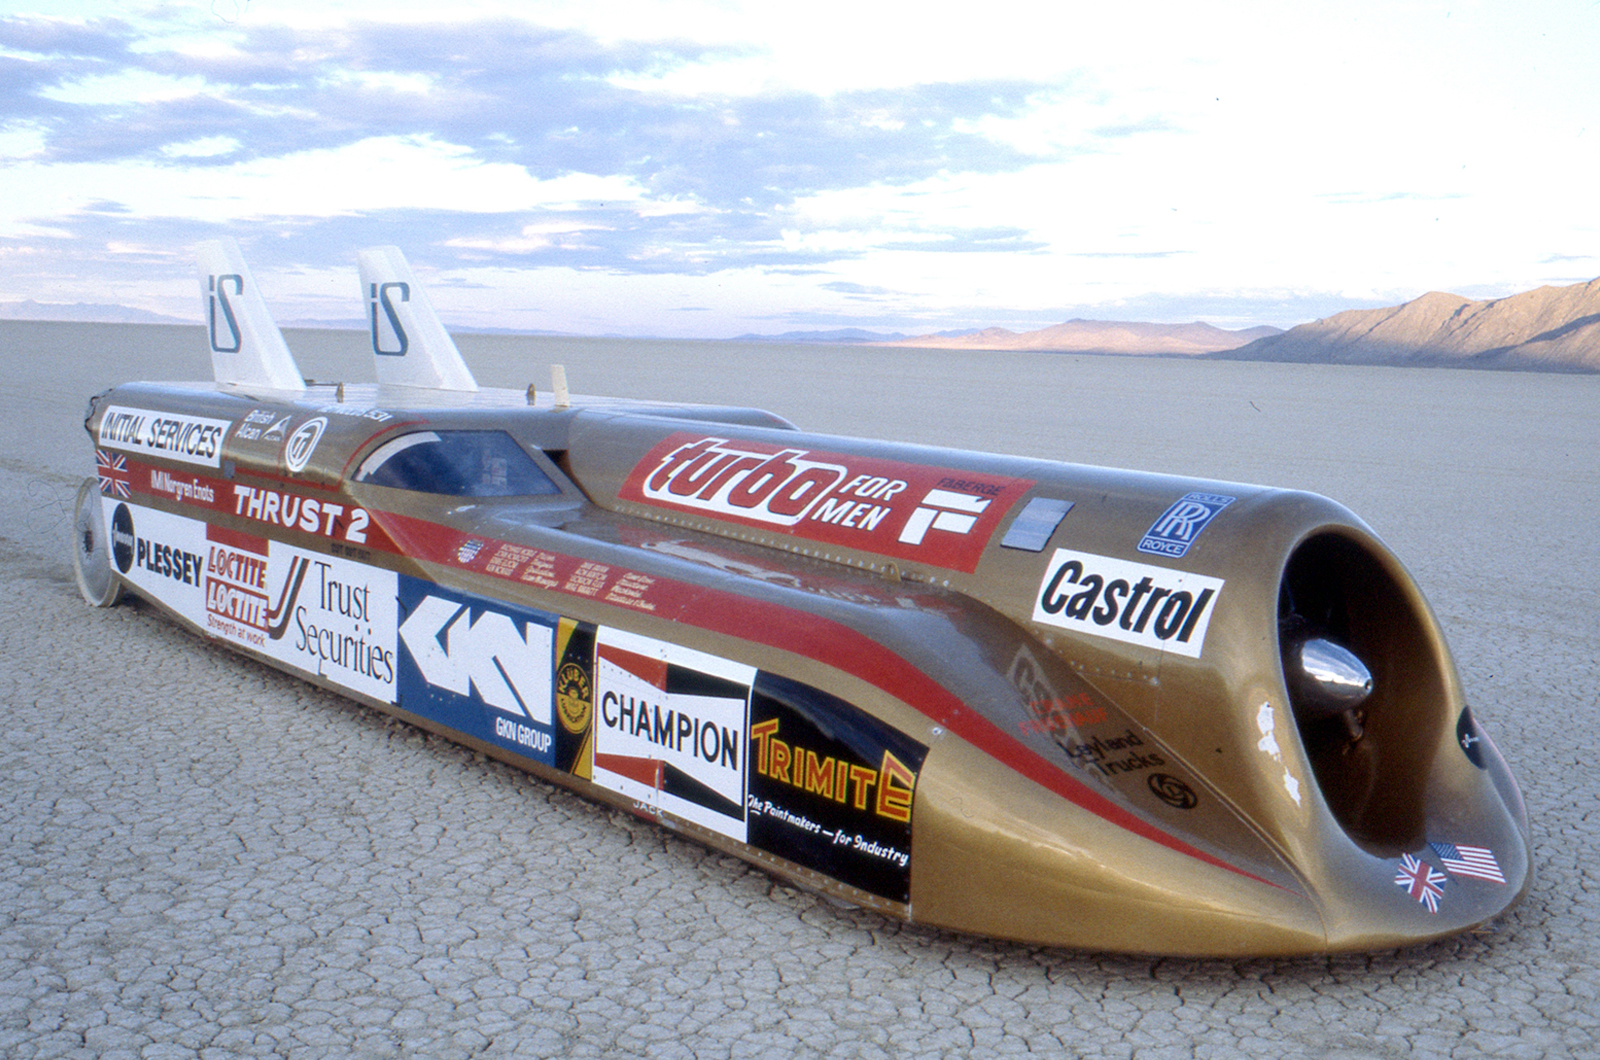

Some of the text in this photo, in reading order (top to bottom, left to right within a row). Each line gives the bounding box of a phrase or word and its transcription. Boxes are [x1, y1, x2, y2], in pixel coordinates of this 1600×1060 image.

[101, 412, 222, 460] INITIAL SERVICES
[235, 423, 262, 441] Alcan
[244, 409, 277, 424] British
[642, 437, 848, 526] turbo
[840, 474, 908, 502] FOR
[233, 485, 370, 544] THRUST 2
[811, 500, 891, 531] MEN
[137, 537, 203, 587] PLESSEY
[207, 546, 268, 590] LOCTITE
[1141, 539, 1185, 554] ROYCE
[207, 586, 269, 630] LOCTITE
[315, 560, 371, 623] Trust
[1041, 559, 1216, 643] Castrol
[207, 613, 266, 648] Strength at work
[296, 605, 394, 685] Securities
[495, 716, 552, 753] GKN GROUP
[602, 690, 738, 771] CHAMPION
[1056, 729, 1144, 760] Leyland
[750, 717, 916, 823] TRIMITE
[1088, 750, 1166, 776] Trucks
[633, 800, 664, 818] JACK
[748, 794, 763, 815] The
[763, 801, 821, 834] Paintmakers
[833, 829, 853, 845] for
